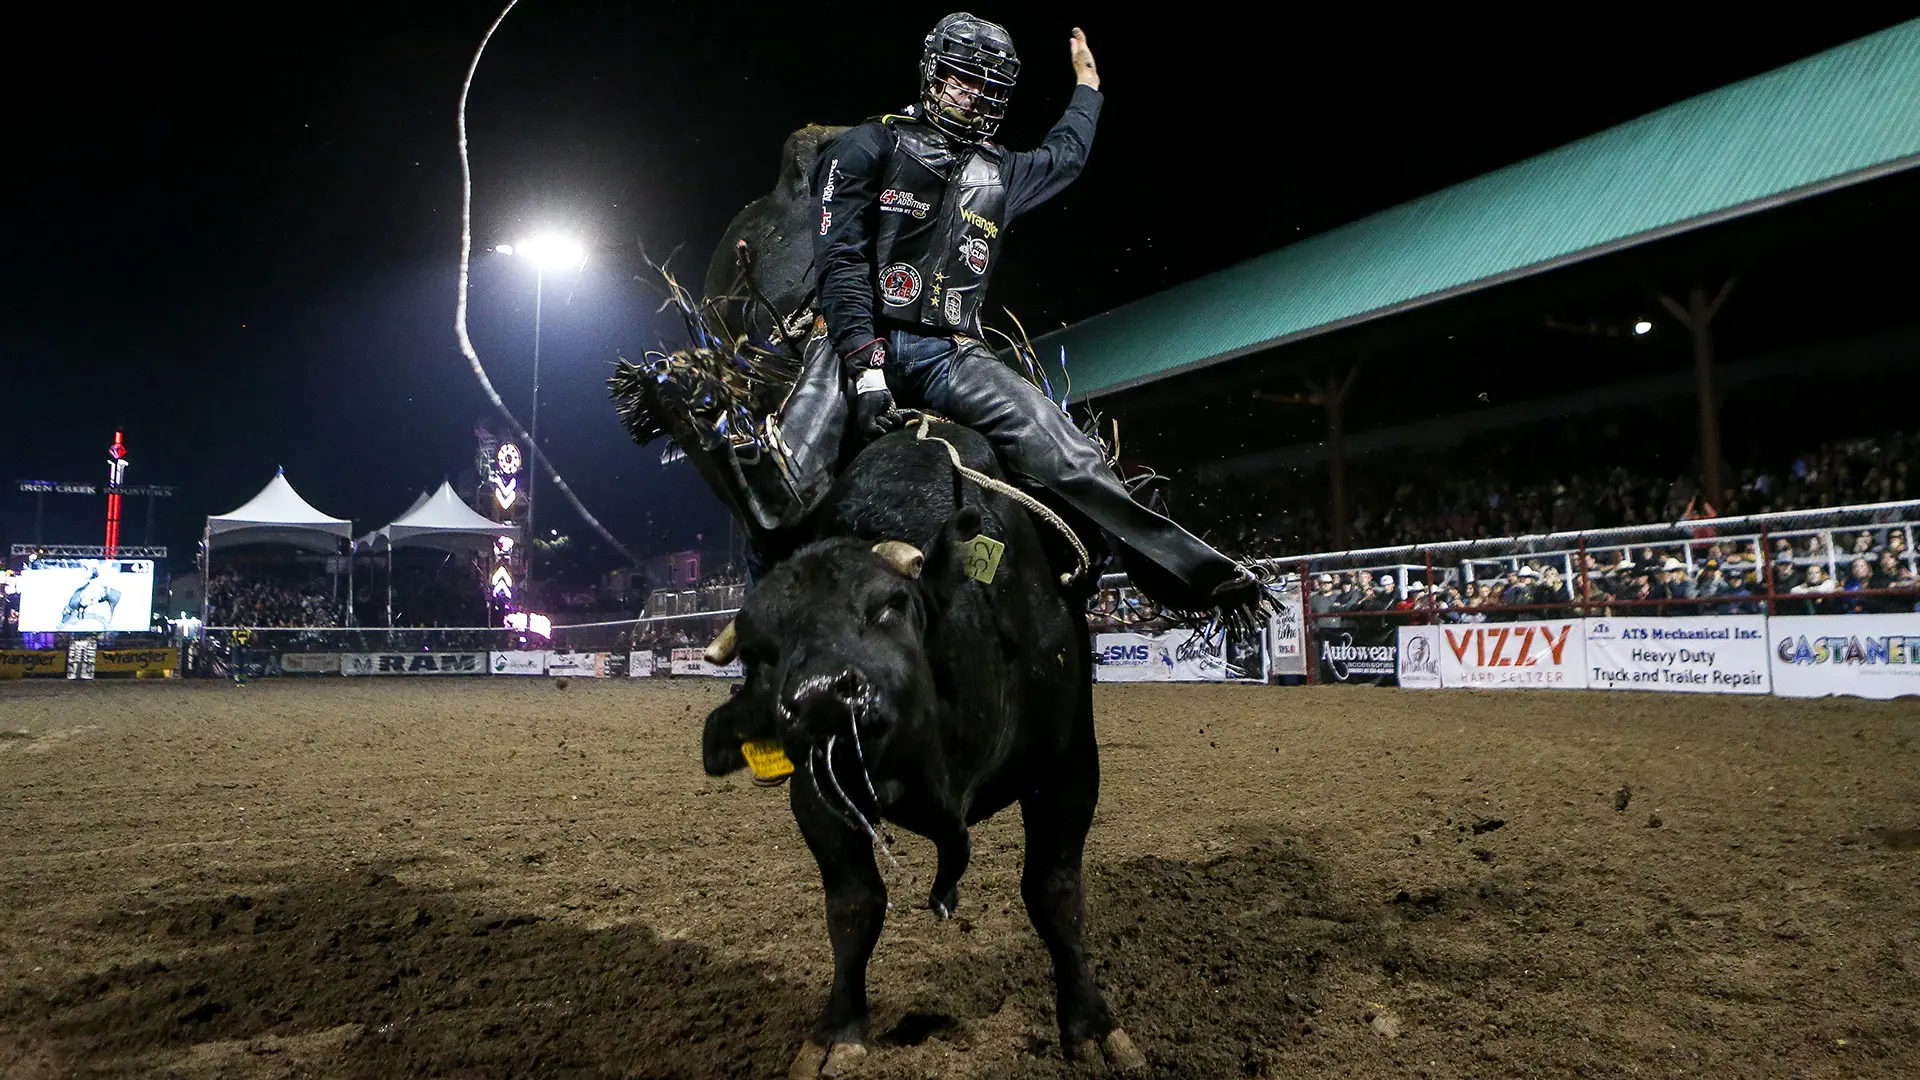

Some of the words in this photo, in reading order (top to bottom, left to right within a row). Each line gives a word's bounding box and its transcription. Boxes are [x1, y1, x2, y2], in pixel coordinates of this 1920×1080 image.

[897, 197, 931, 211] ADDITIVES
[898, 191, 914, 201] FUEL
[20, 483, 52, 492] IRON
[55, 485, 96, 494] CREEK
[1622, 628, 1648, 640] ATS
[1652, 627, 1729, 640] Mechanical
[1735, 628, 1762, 640] Inc.
[1322, 634, 1396, 669] Autowear
[1445, 624, 1572, 667] VIZZY
[1, 653, 56, 670] rangler
[103, 651, 169, 668] Wrangler
[379, 655, 475, 672] RAM
[1632, 648, 1676, 665] Heavy
[1680, 649, 1716, 666] Duty
[1460, 675, 1496, 684] HARD
[1501, 674, 1565, 684] SELTZER
[1593, 668, 1630, 682] Truck
[1633, 668, 1659, 682] and
[1663, 669, 1709, 684] Trailer
[1713, 670, 1763, 688] Repair
